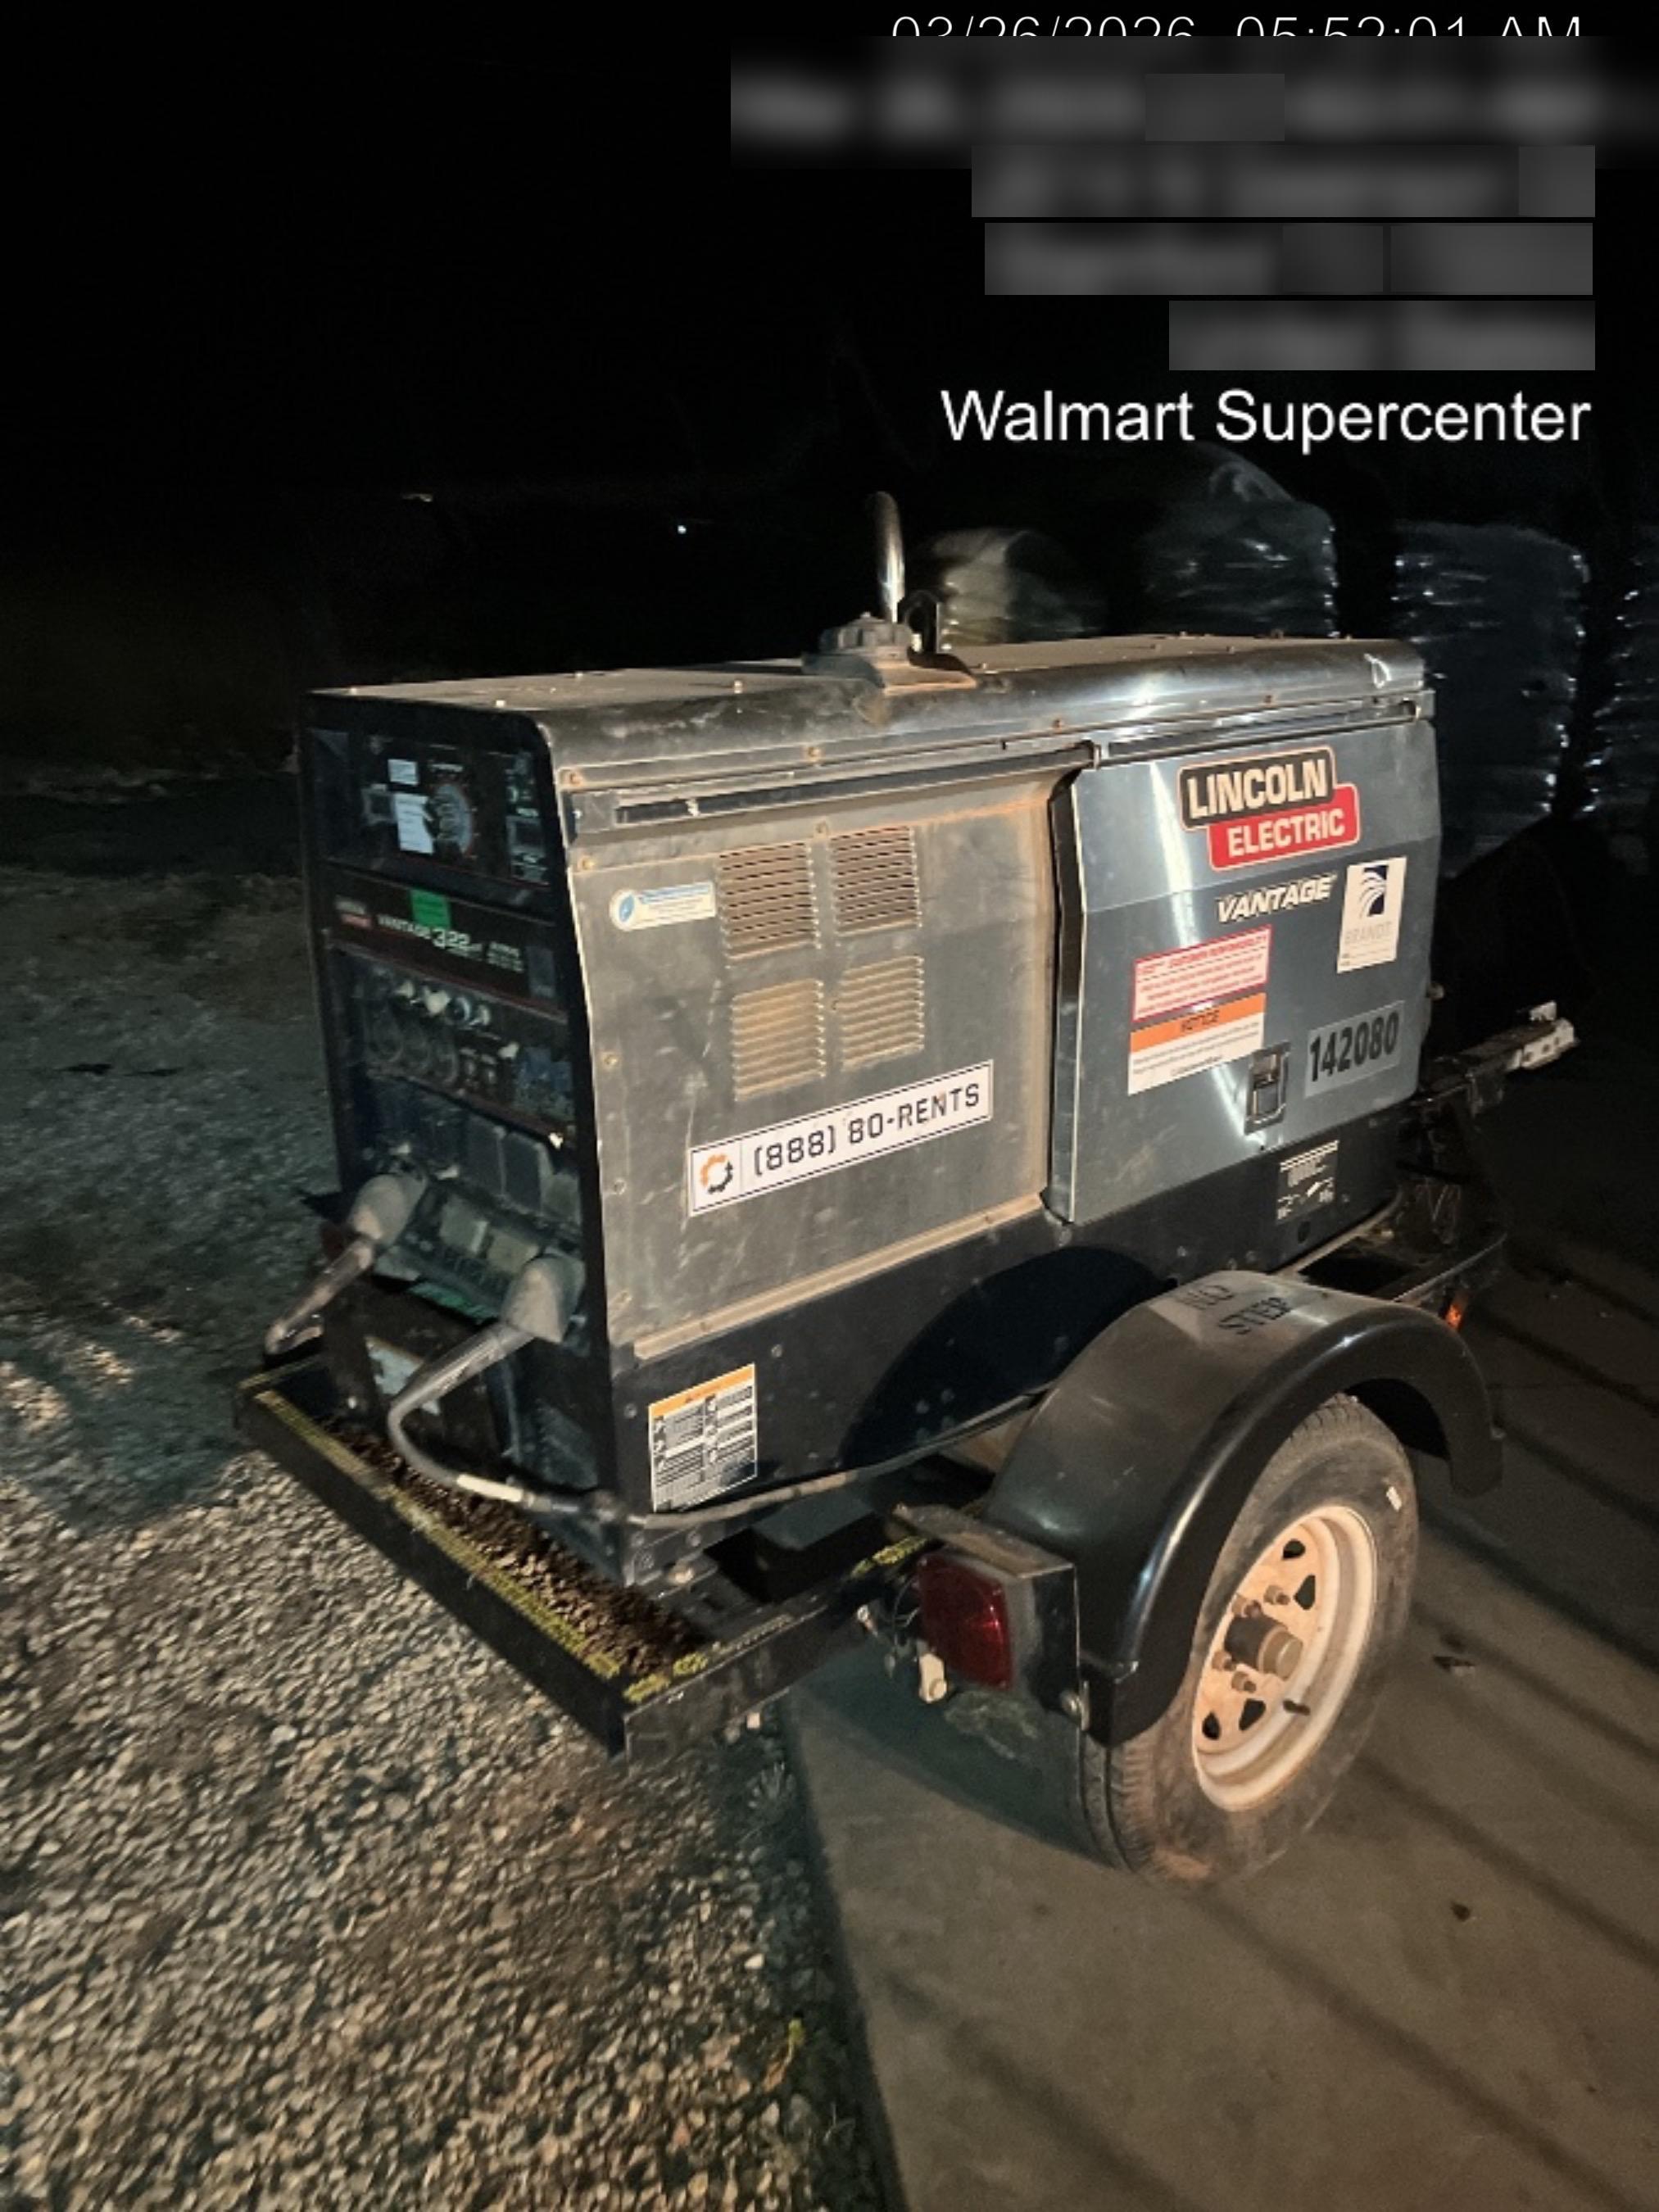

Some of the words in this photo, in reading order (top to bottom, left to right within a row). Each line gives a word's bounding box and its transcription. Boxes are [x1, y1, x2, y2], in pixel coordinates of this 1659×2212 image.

[1187, 759, 1327, 819] LINCOLN
[1228, 808, 1346, 858] ELECTRIC
[1216, 876, 1333, 924] VANTAGE
[432, 927, 471, 950] 322
[1309, 1011, 1400, 1083] 142080
[754, 1125, 837, 1176] (888)
[849, 1083, 980, 1145] 80-RENTS
